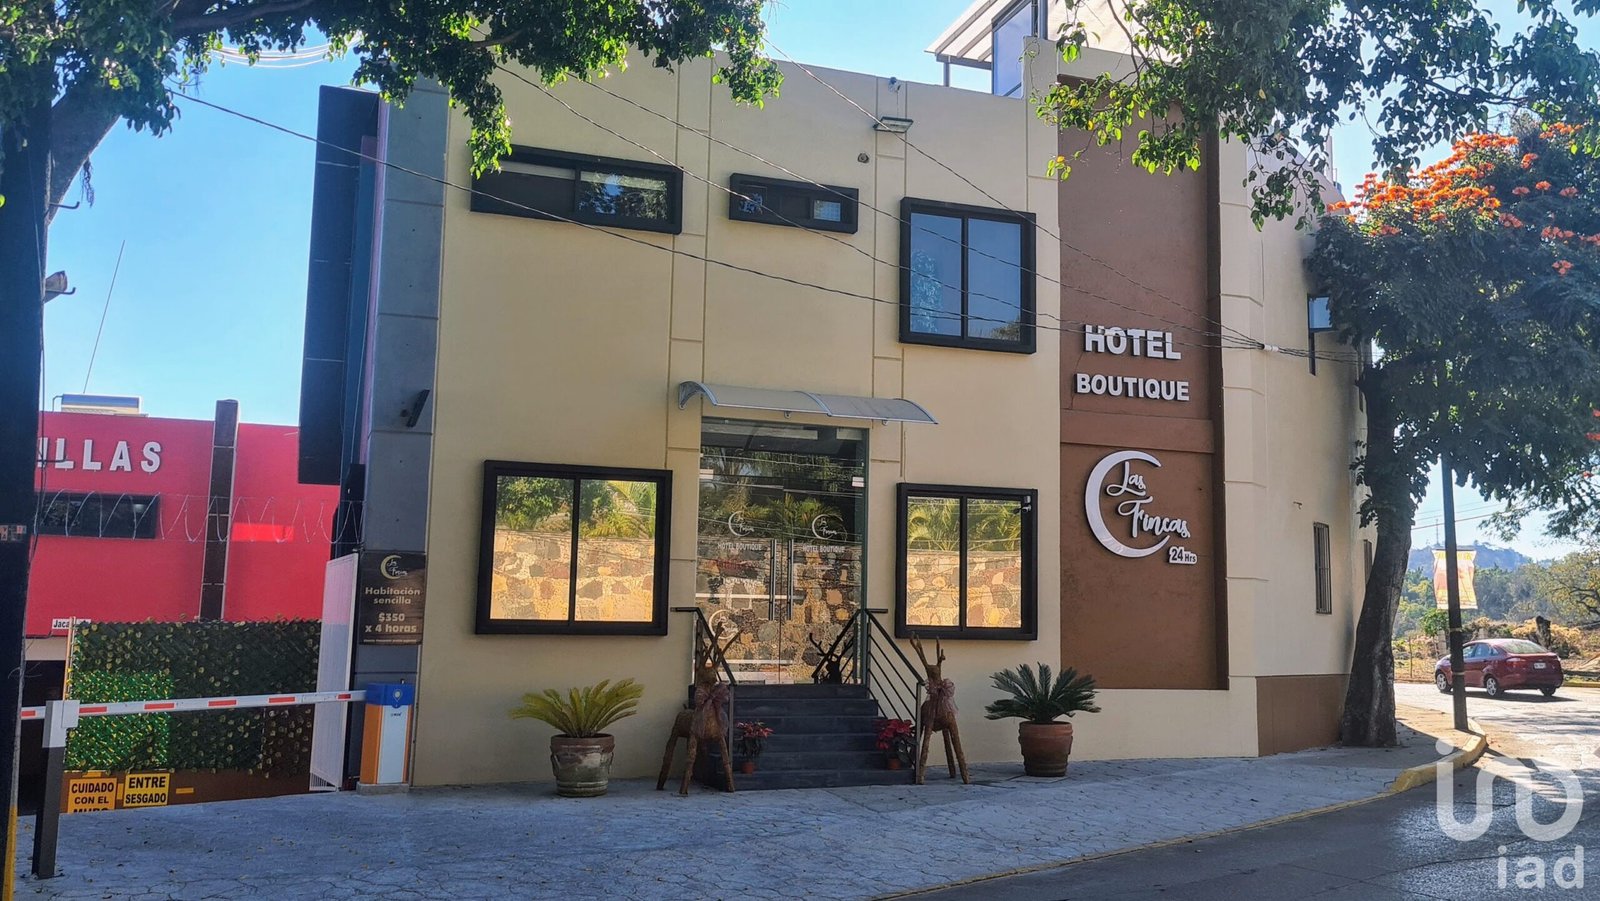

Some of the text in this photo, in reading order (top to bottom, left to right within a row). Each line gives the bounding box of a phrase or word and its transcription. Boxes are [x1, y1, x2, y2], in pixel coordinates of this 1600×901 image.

[1083, 323, 1182, 361] HOTEL
[1075, 373, 1190, 402] BOUTIQUE
[1106, 461, 1147, 497] Las
[1118, 496, 1191, 538] Fincas
[1171, 548, 1196, 562] 24 Hrs
[364, 587, 421, 595] Habitación
[373, 596, 412, 605] sencilla
[378, 612, 405, 622] $350
[375, 624, 382, 633] 4
[385, 623, 417, 633] horas
[71, 782, 115, 794] CUIDADO
[128, 776, 167, 789] ENTRE
[74, 796, 110, 805] CON EL
[125, 793, 167, 804] SESGADO
